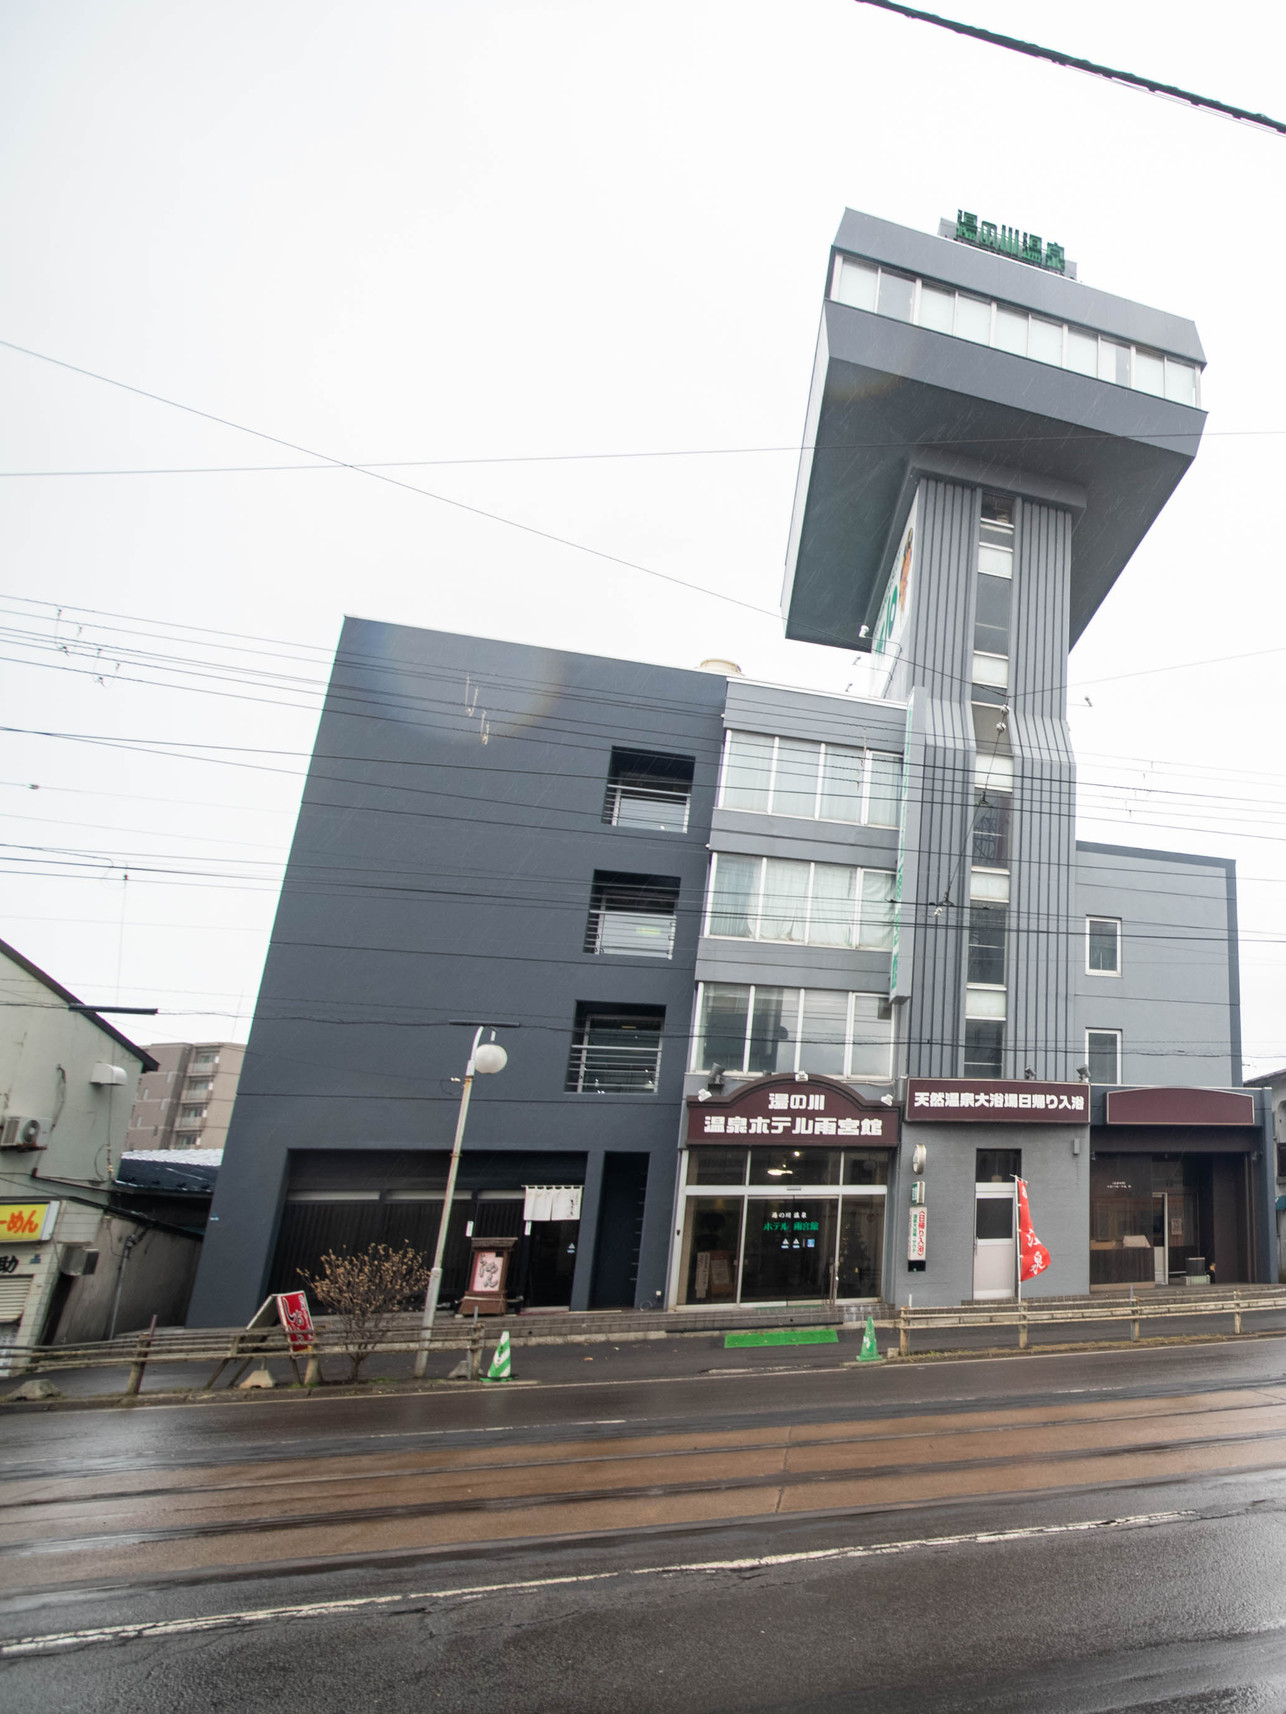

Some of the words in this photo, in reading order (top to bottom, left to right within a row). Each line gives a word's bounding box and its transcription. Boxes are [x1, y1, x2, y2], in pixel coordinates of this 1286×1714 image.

[768, 1093, 826, 1111] 湯の川
[914, 1092, 1085, 1111] 天然温泉大浴場日帰り入浴
[704, 1115, 882, 1137] 温泉ホテル雨宮館
